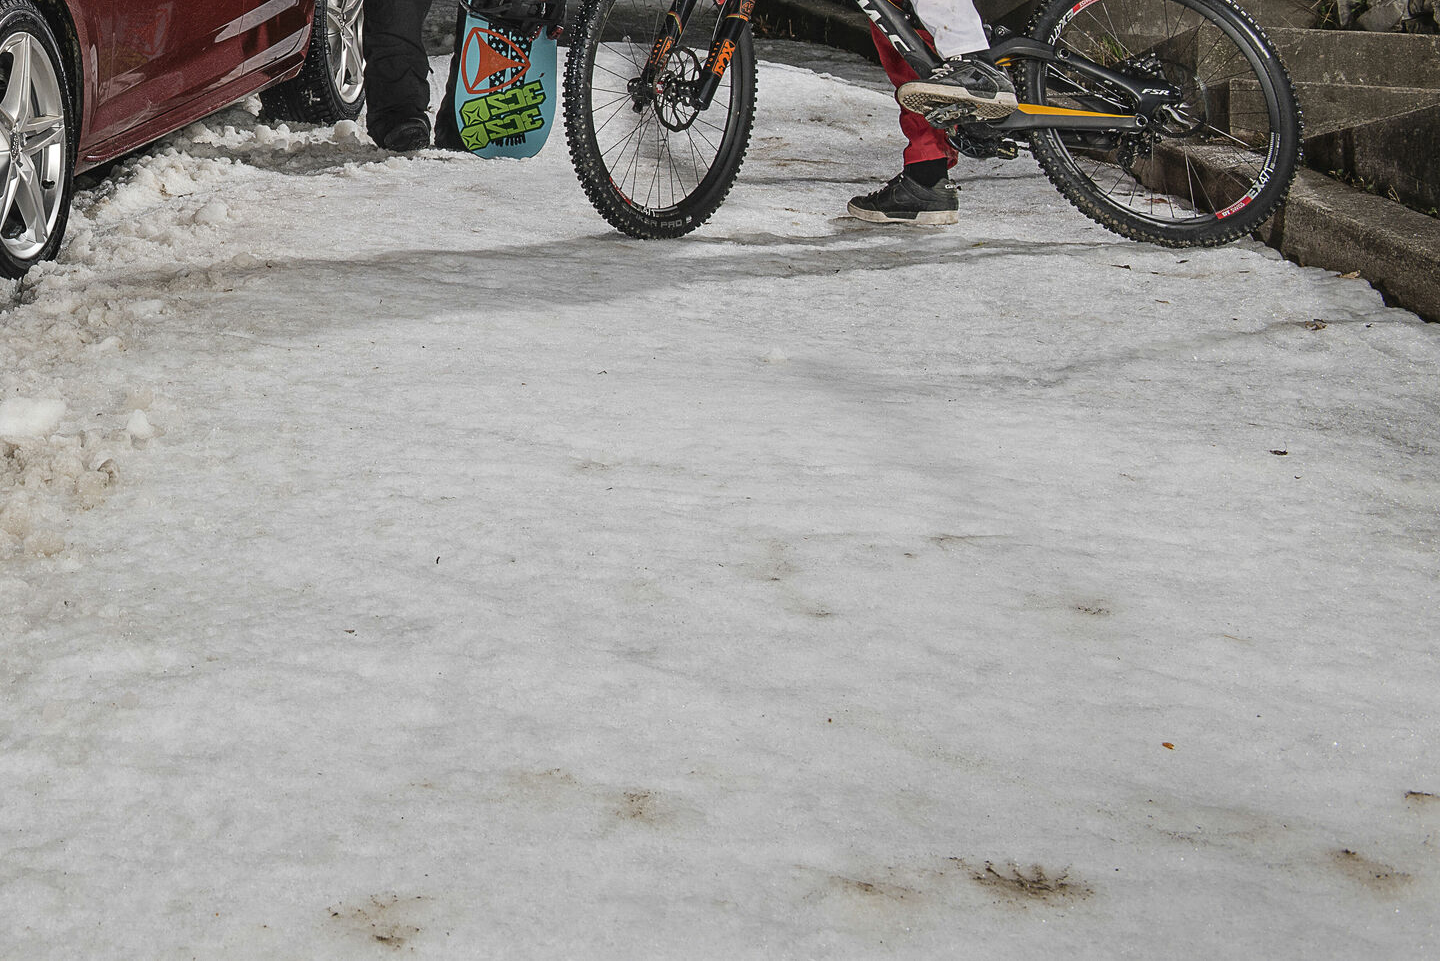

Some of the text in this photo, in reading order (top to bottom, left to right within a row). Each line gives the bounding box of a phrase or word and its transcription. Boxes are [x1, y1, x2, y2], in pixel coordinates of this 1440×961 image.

[713, 40, 736, 76] FOX
[1141, 88, 1170, 96] FSR
[1221, 209, 1231, 217] DT
